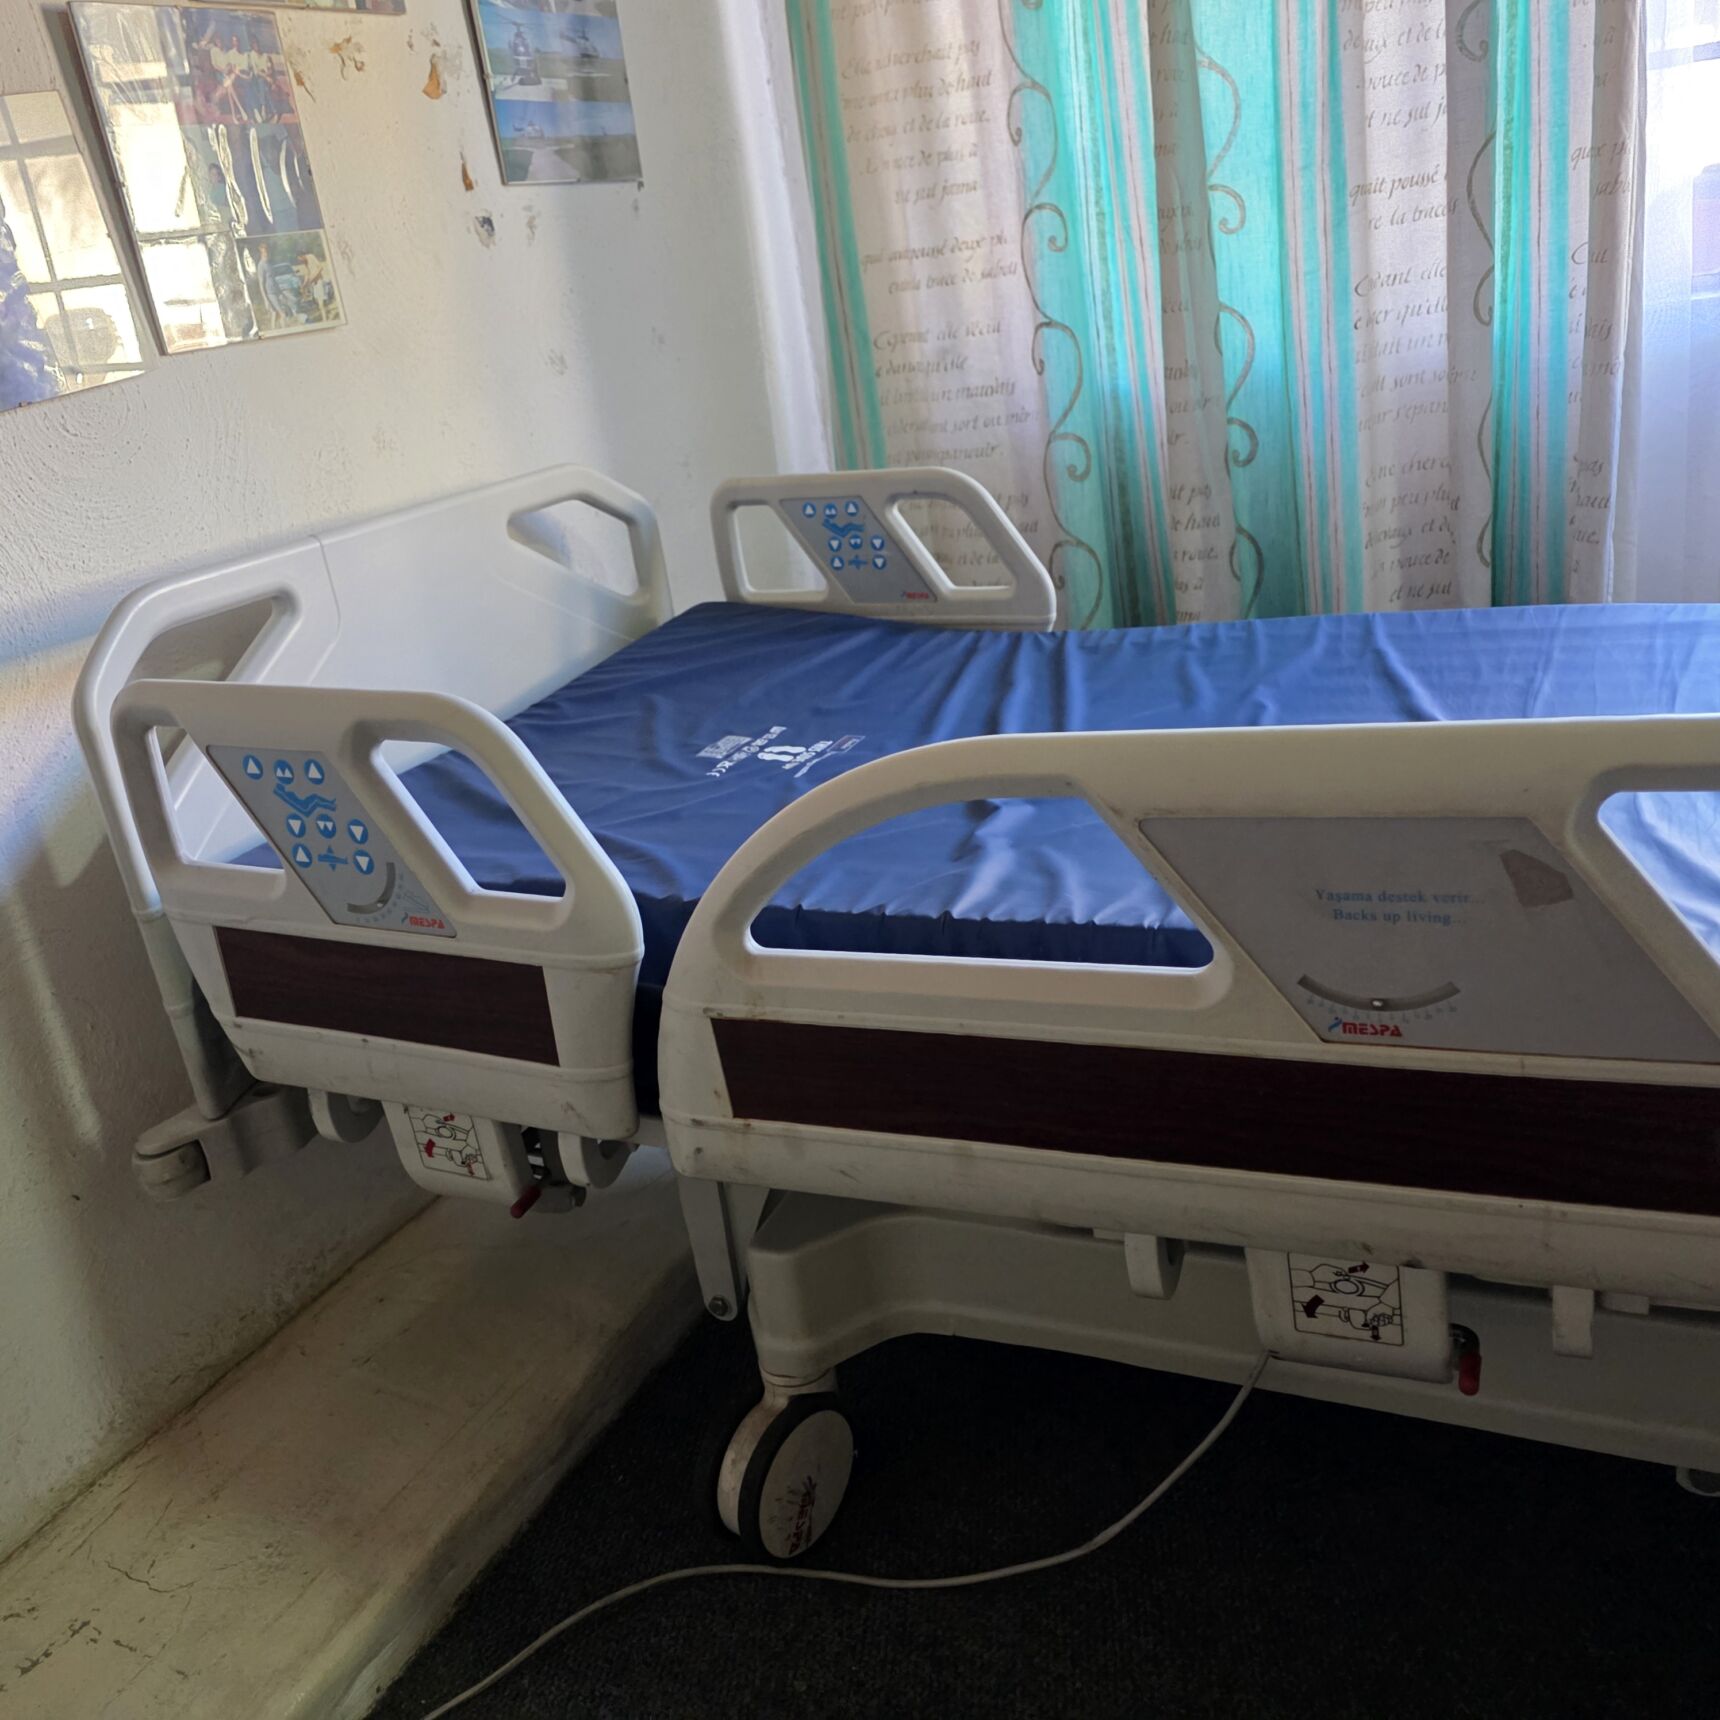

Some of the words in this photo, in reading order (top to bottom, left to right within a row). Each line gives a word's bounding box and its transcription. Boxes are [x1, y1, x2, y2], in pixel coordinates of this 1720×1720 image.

[1378, 890, 1426, 904] destek
[409, 916, 445, 929] MESPA
[1333, 908, 1377, 922] Backs
[1382, 911, 1401, 925] up
[1342, 1021, 1403, 1037] MESPA
